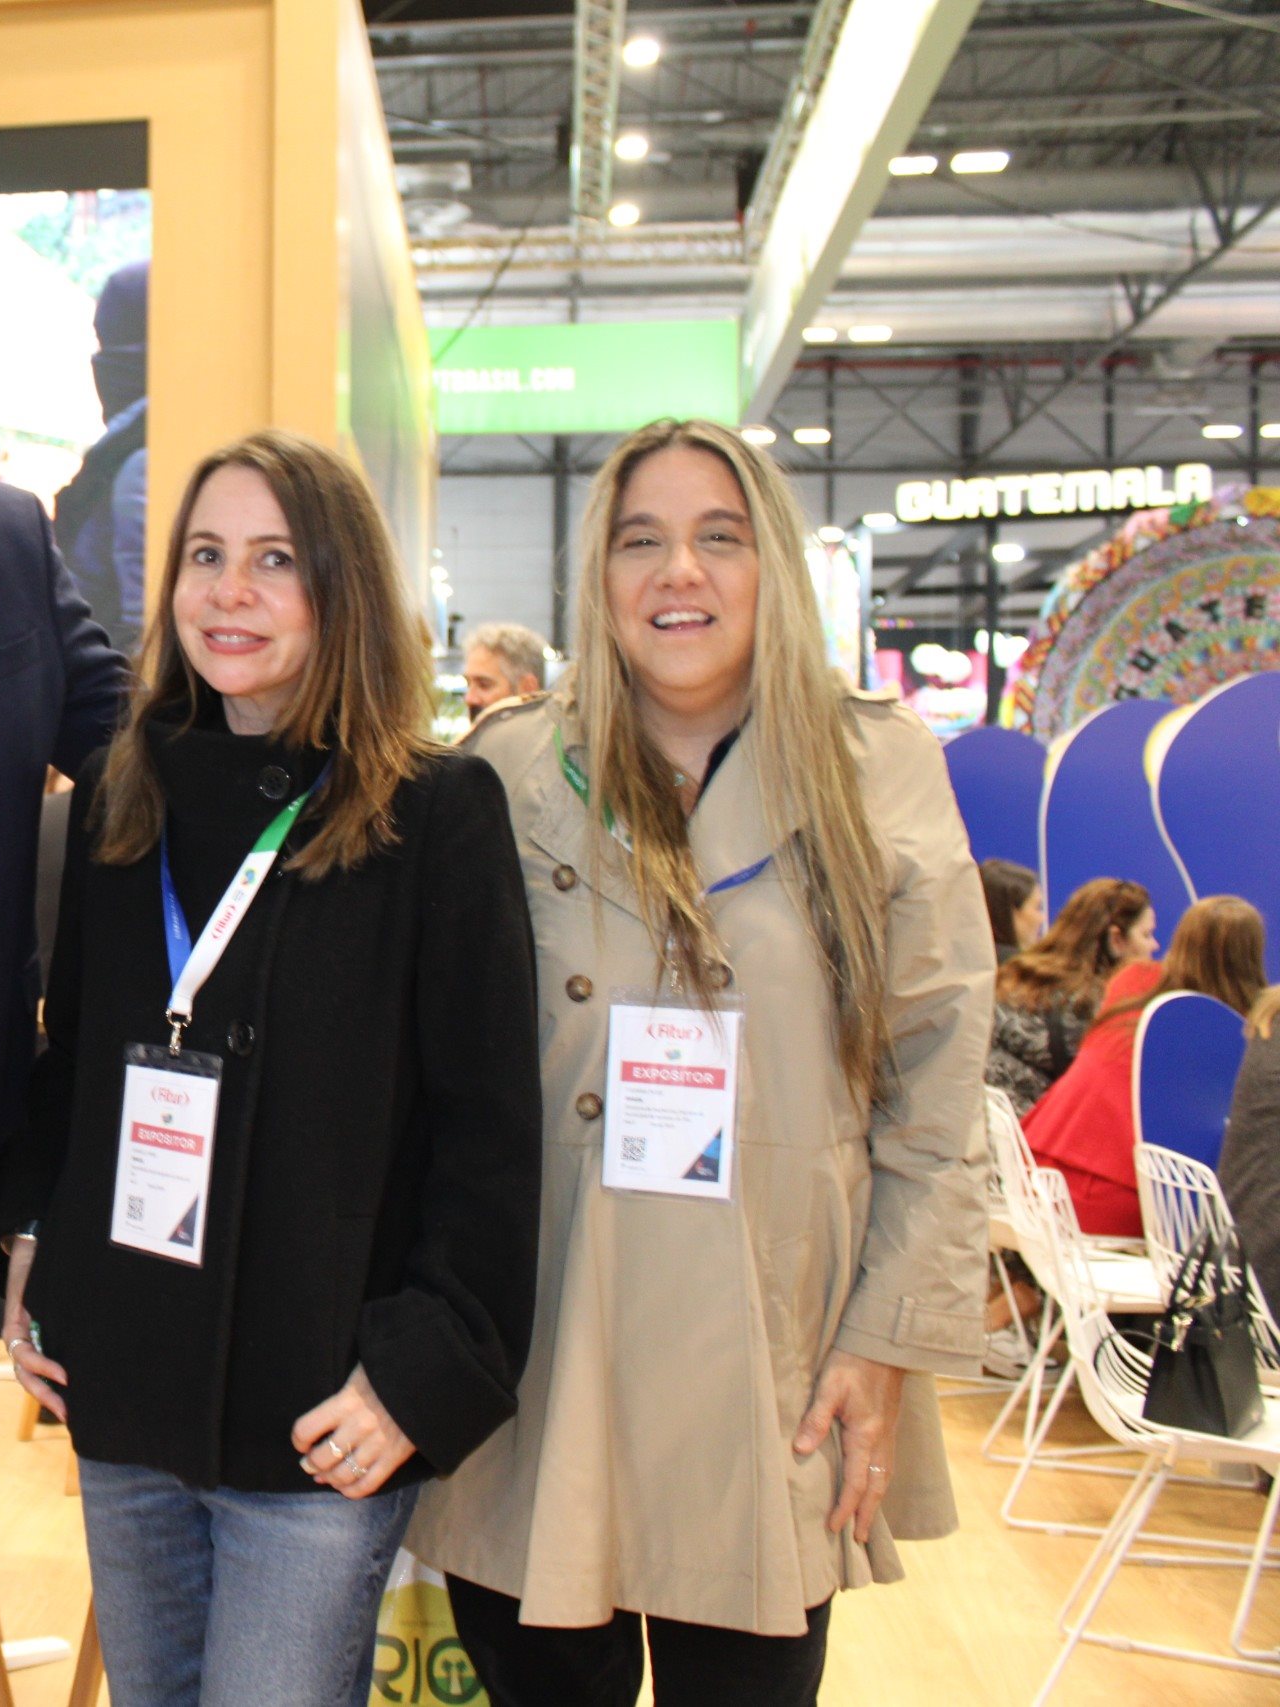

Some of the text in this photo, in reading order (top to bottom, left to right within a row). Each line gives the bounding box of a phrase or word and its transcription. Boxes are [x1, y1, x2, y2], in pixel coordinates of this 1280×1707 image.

[896, 463, 1213, 522] GUATEMALA
[632, 1066, 715, 1085] EXPOSITOR
[137, 1127, 197, 1151] EXPOSITOR
